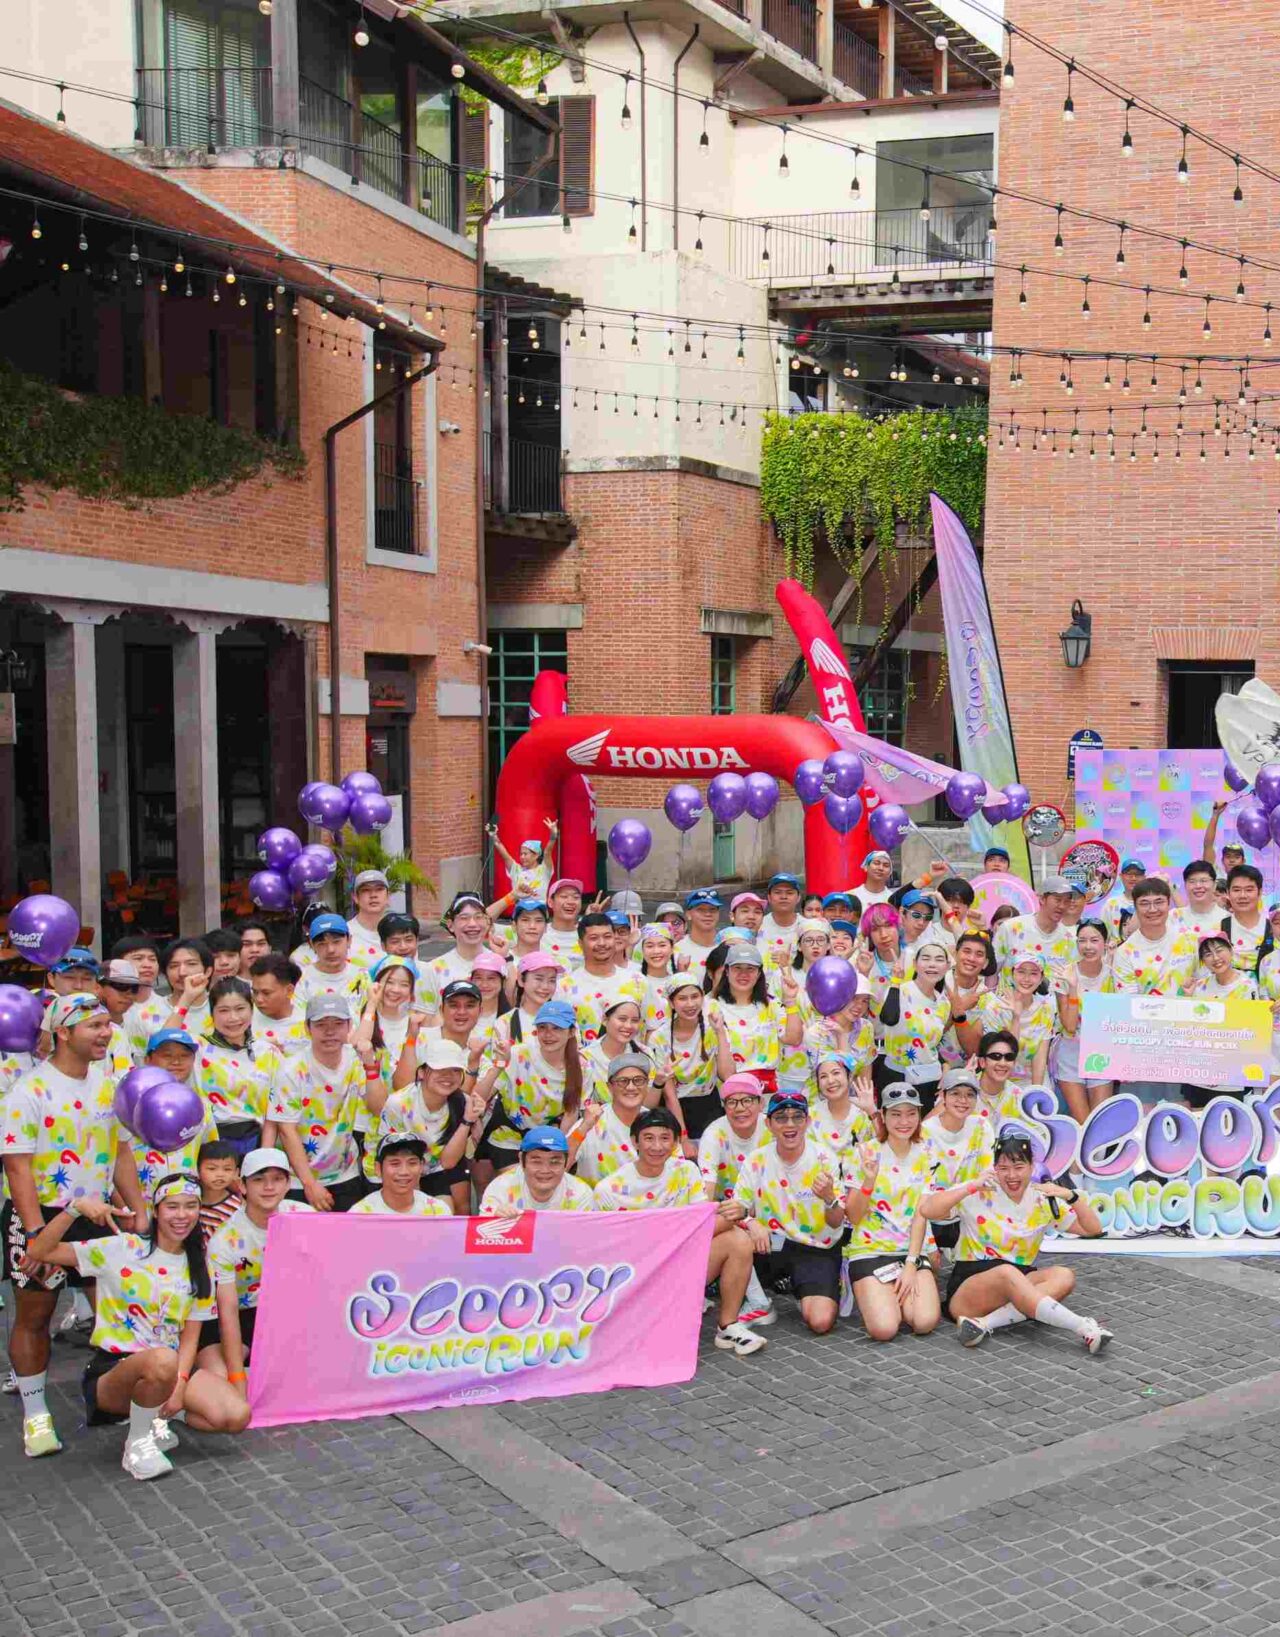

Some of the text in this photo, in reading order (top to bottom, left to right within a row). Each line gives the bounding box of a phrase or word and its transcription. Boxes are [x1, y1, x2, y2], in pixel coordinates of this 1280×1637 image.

[607, 746, 751, 770] HONDA
[474, 1238, 523, 1246] HONDA
[348, 1263, 633, 1340] SCOOPY
[486, 1326, 595, 1375] RUN
